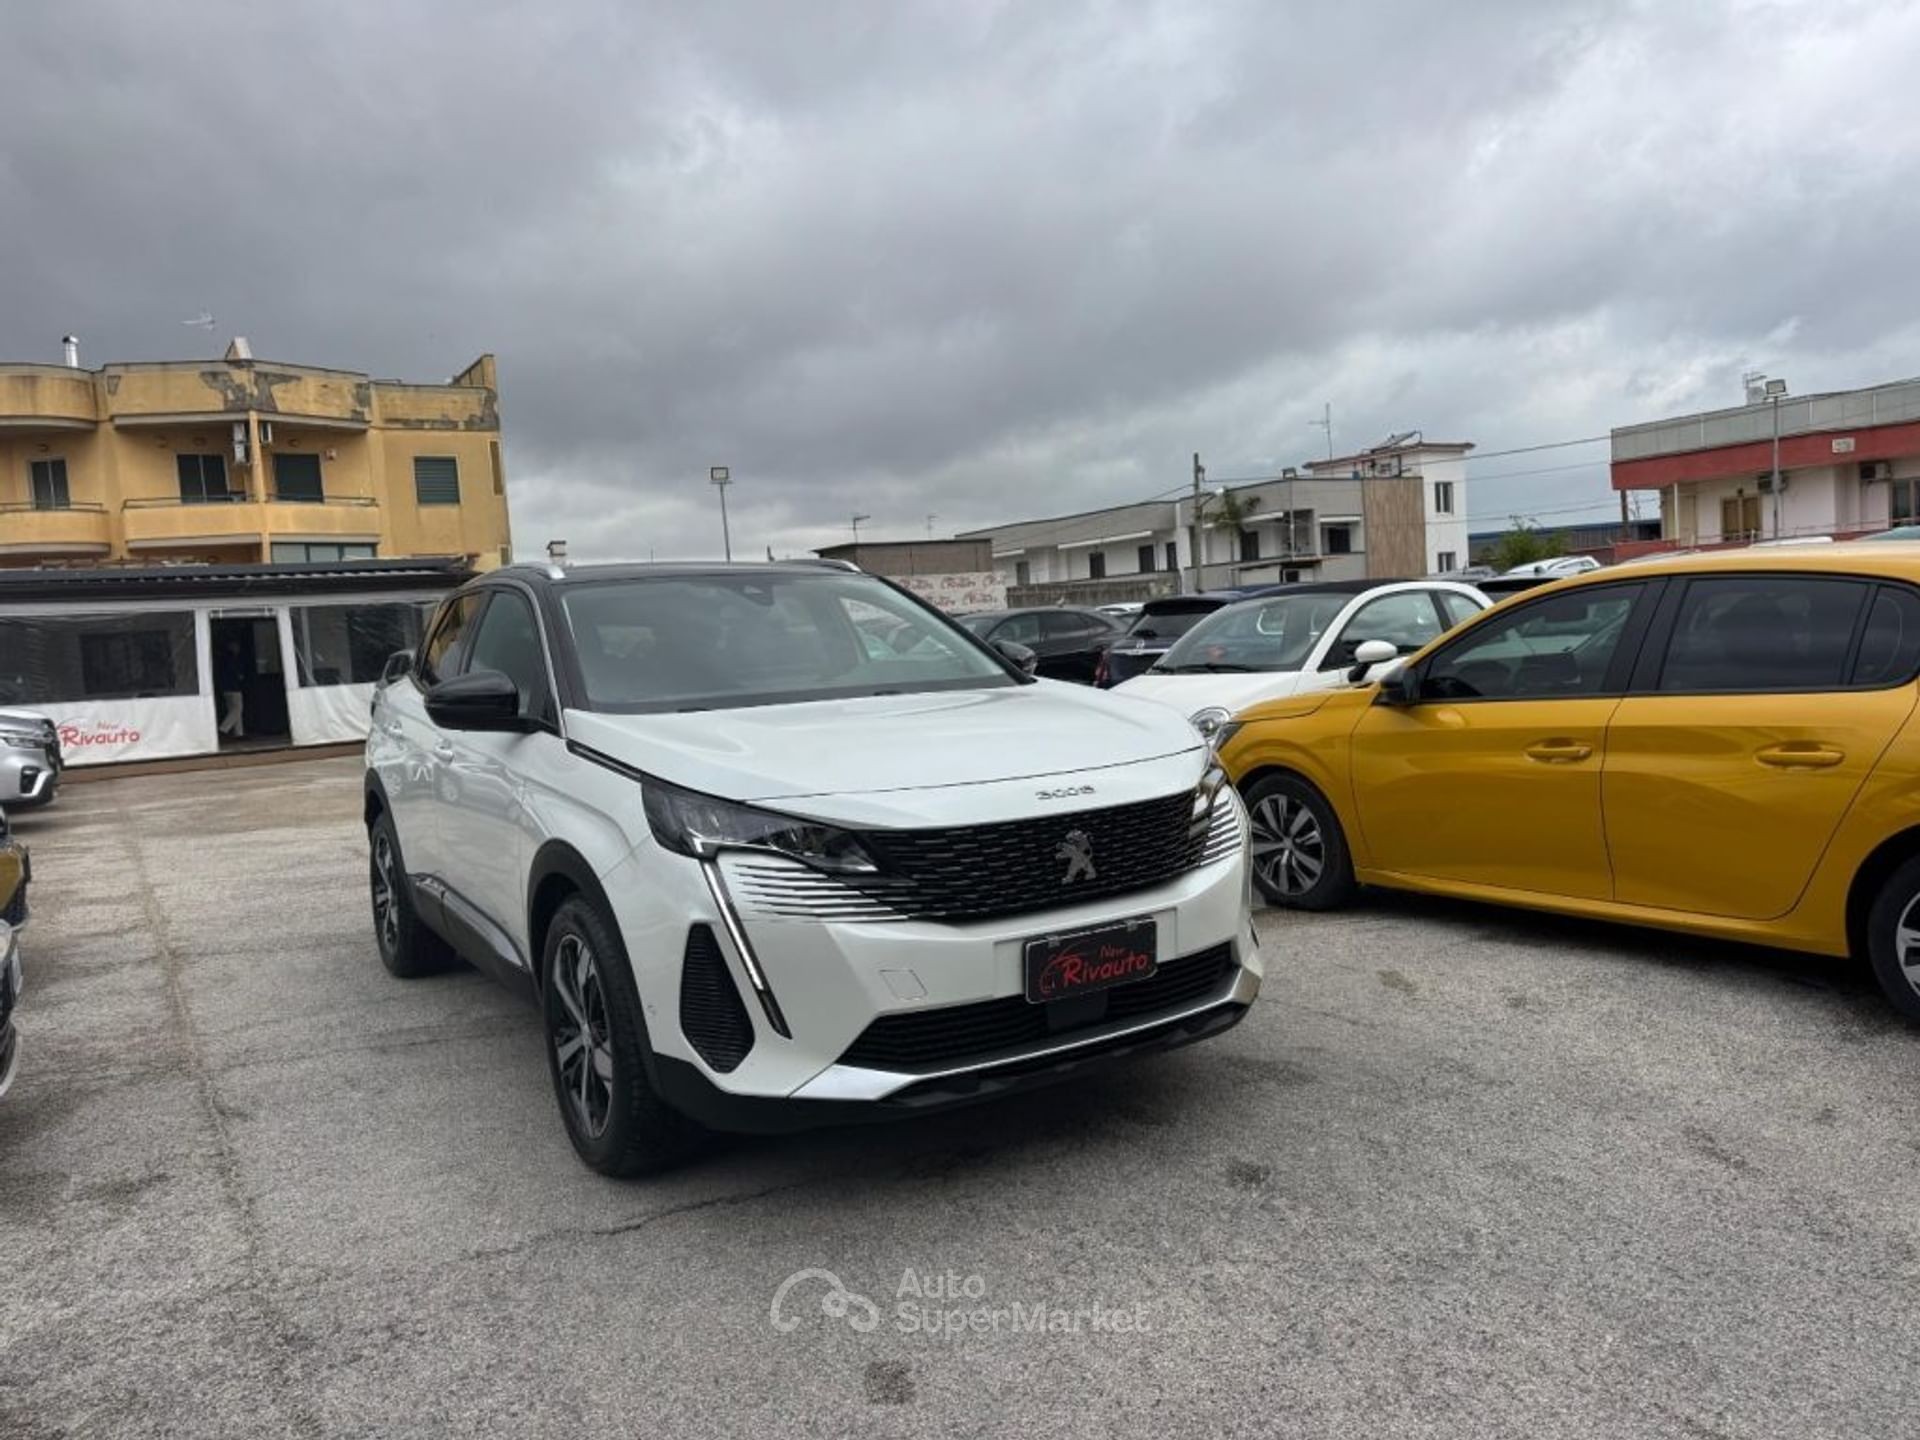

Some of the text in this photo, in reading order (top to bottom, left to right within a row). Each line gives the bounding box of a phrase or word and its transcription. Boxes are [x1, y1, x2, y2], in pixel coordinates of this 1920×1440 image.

[60, 725, 140, 747] Rivauto
[1035, 785, 1095, 800] 3008
[1060, 950, 1149, 988] Rivauto
